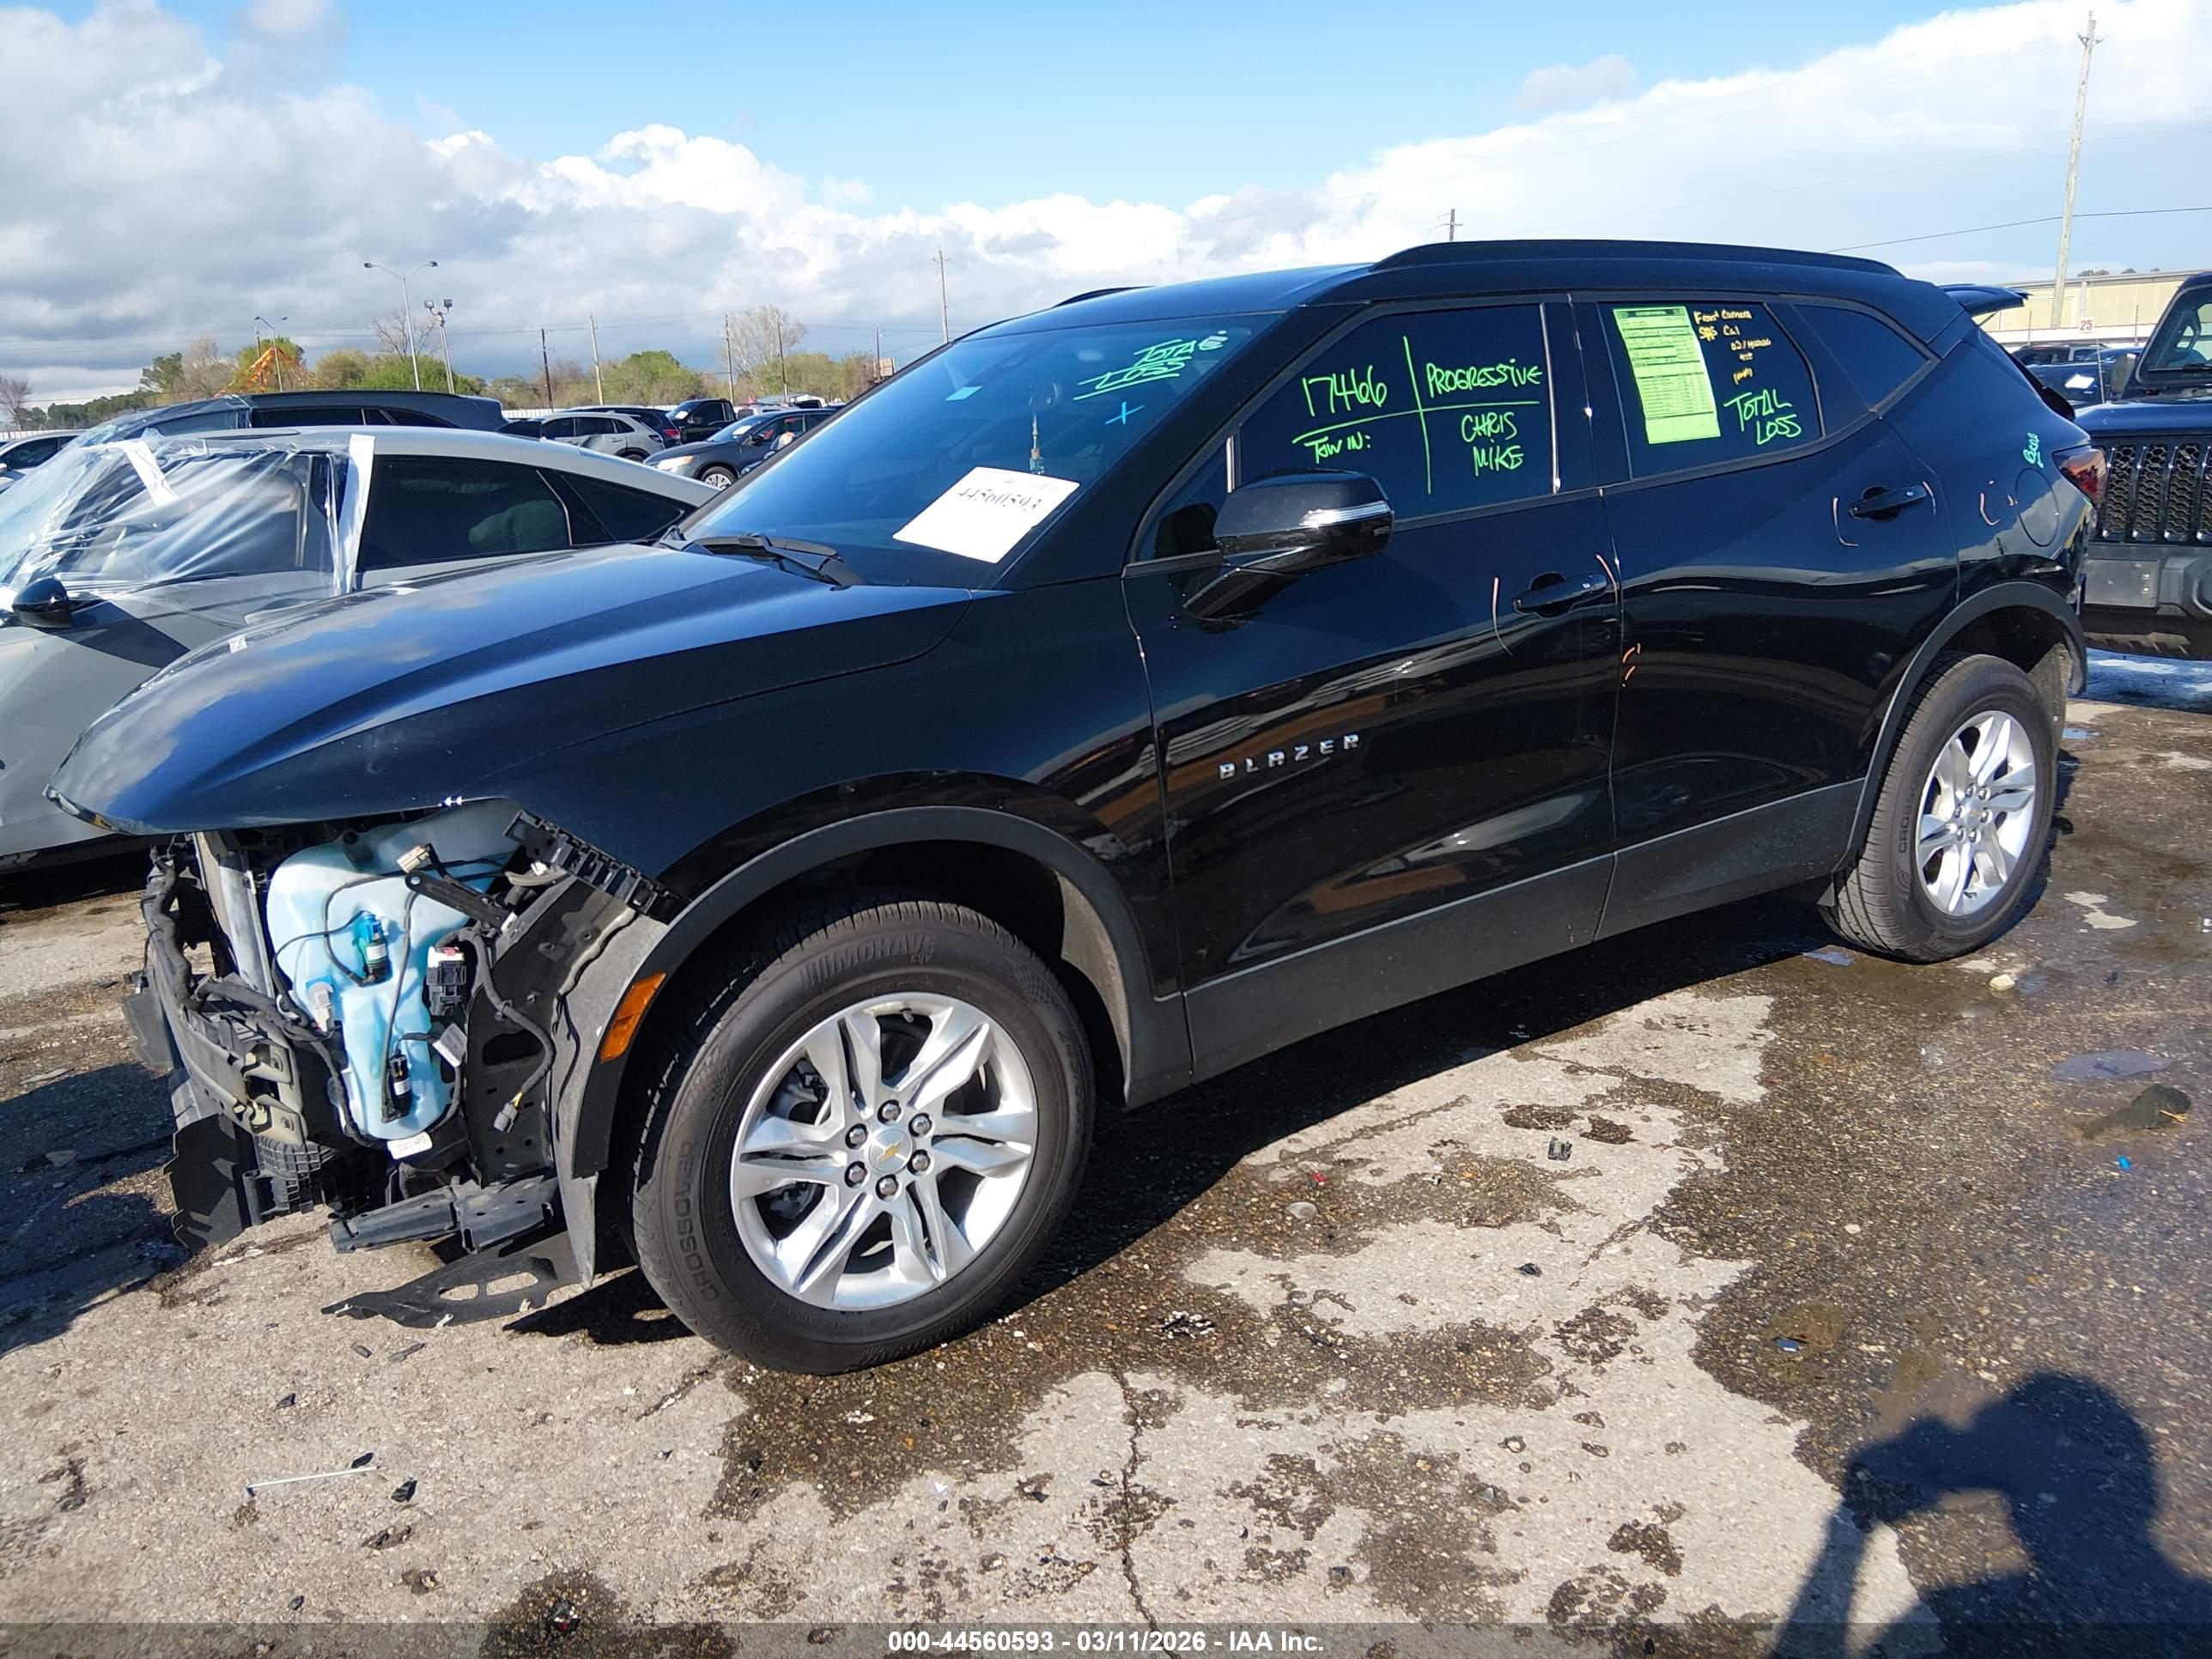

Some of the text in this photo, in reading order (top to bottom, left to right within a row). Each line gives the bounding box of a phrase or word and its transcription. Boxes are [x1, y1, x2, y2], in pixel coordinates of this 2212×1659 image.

[2080, 319, 2094, 331] 25
[1461, 411, 1518, 443] CHRIS
[1723, 389, 1793, 432] TOTAL
[1756, 414, 1802, 446] LOSS
[1472, 438, 1525, 477] MIKE
[1218, 733, 1360, 781] BLAZER
